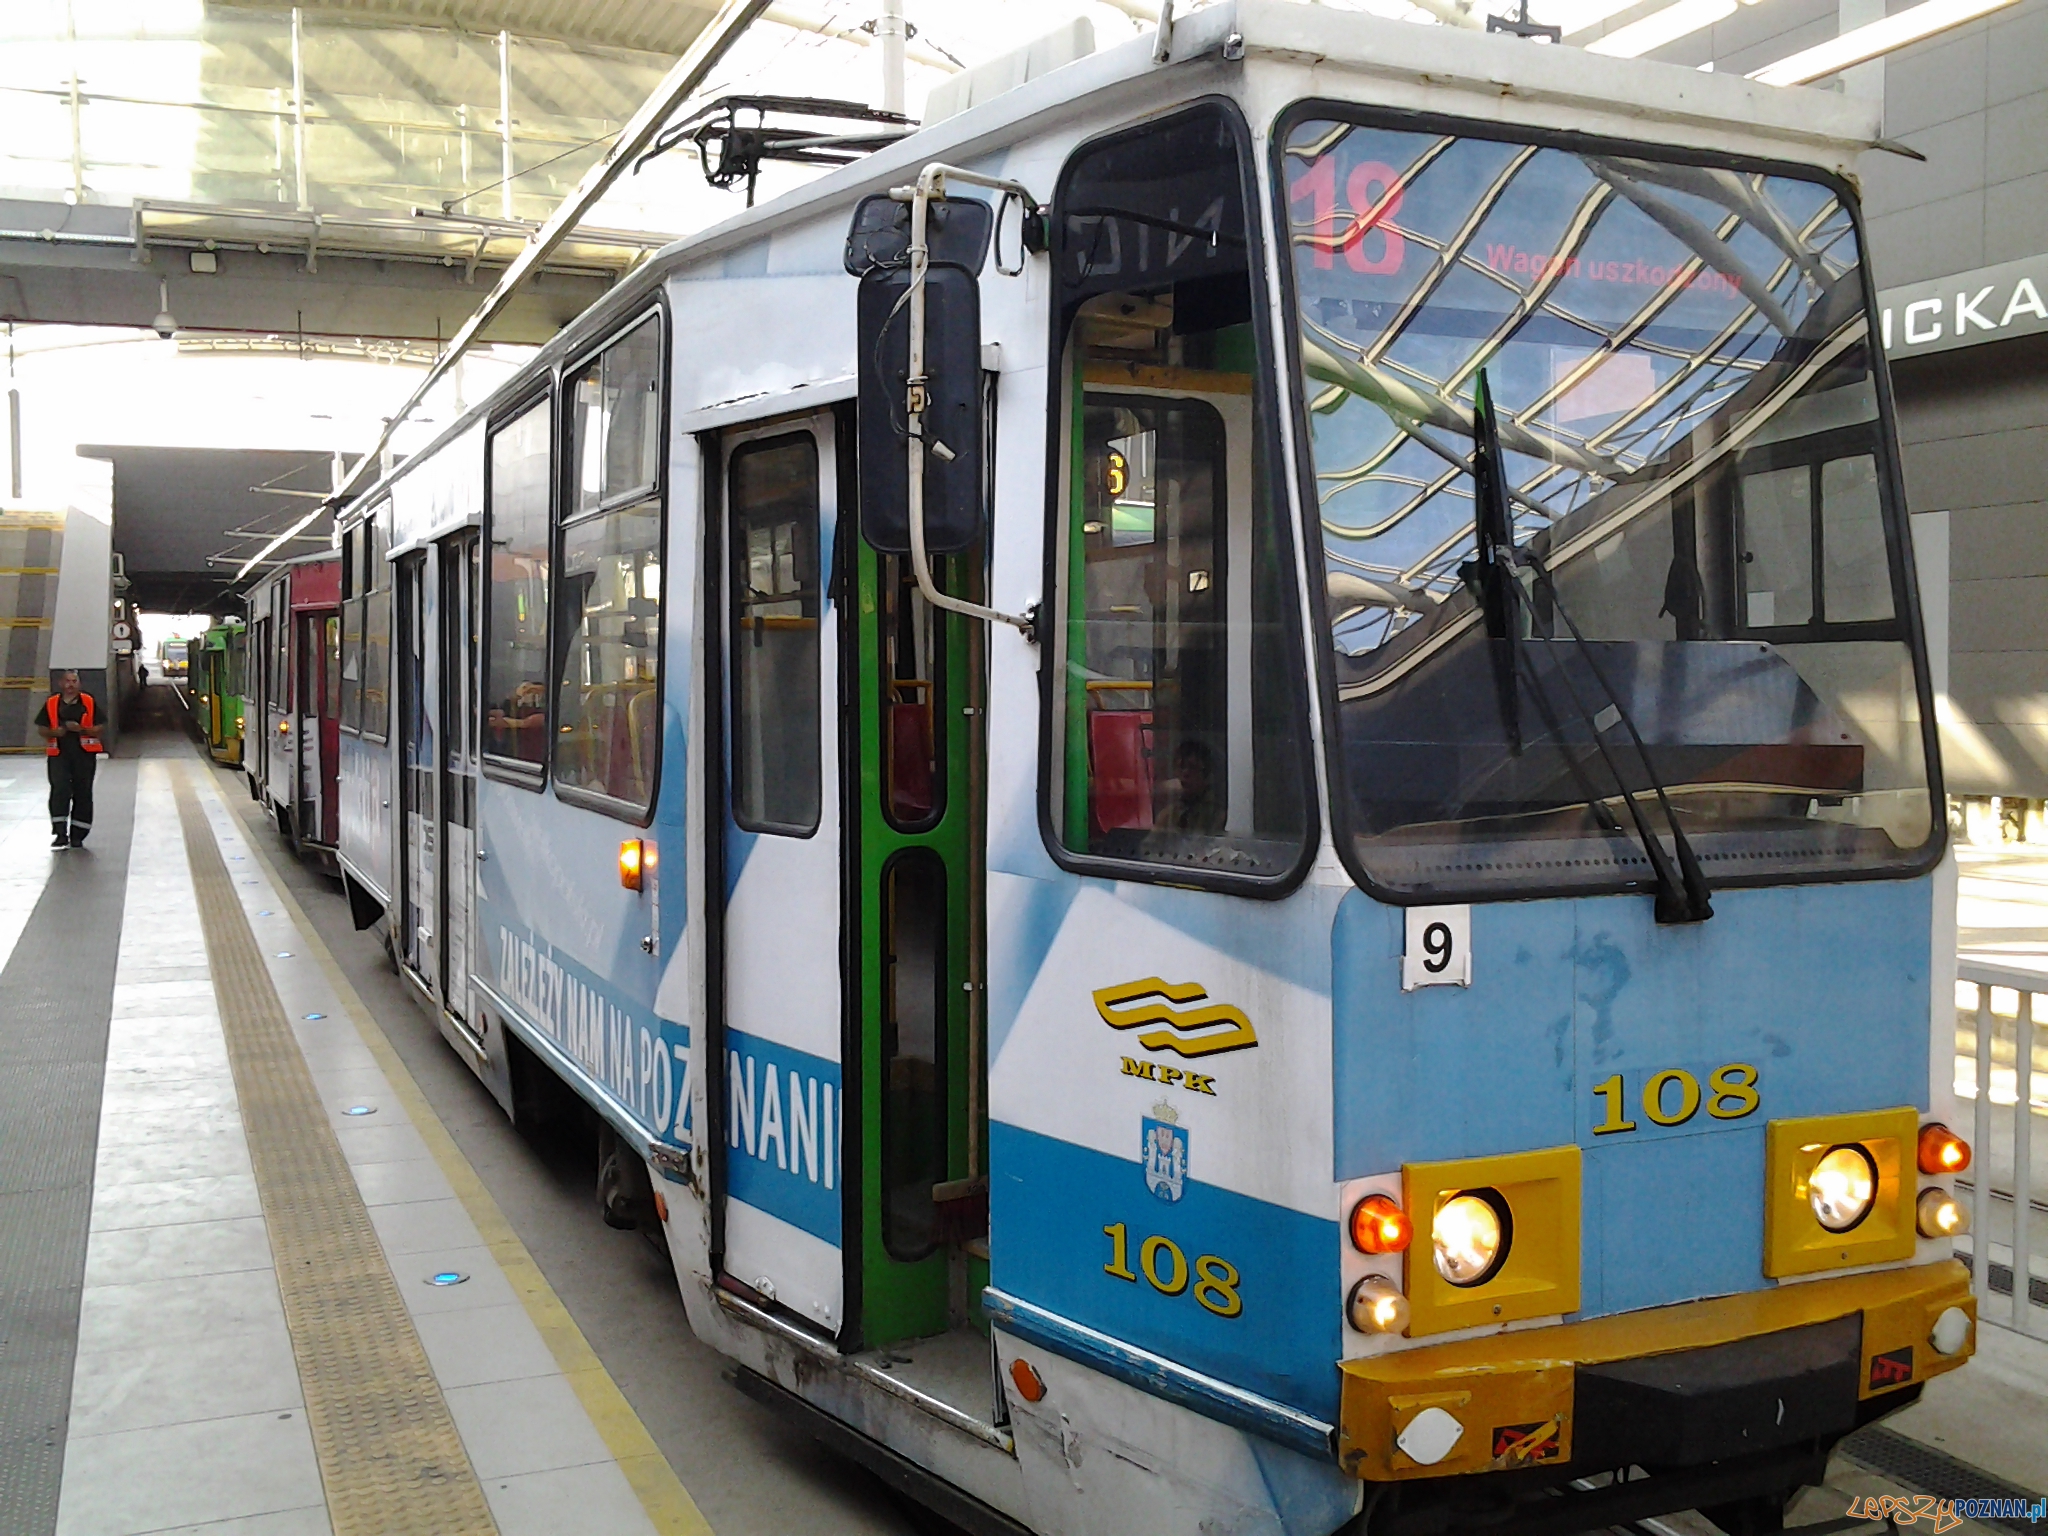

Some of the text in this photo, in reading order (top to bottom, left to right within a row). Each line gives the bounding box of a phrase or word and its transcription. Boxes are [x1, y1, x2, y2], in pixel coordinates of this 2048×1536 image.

[1291, 155, 1405, 275] 18
[1488, 243, 1741, 299] Wagon uszkodzony
[1423, 922, 1452, 973] 9
[567, 973, 605, 1080] NAM
[609, 1004, 635, 1107] NA
[1120, 1056, 1217, 1096] MPK
[1592, 1063, 1760, 1136] 108
[1102, 1222, 1244, 1319] 108
